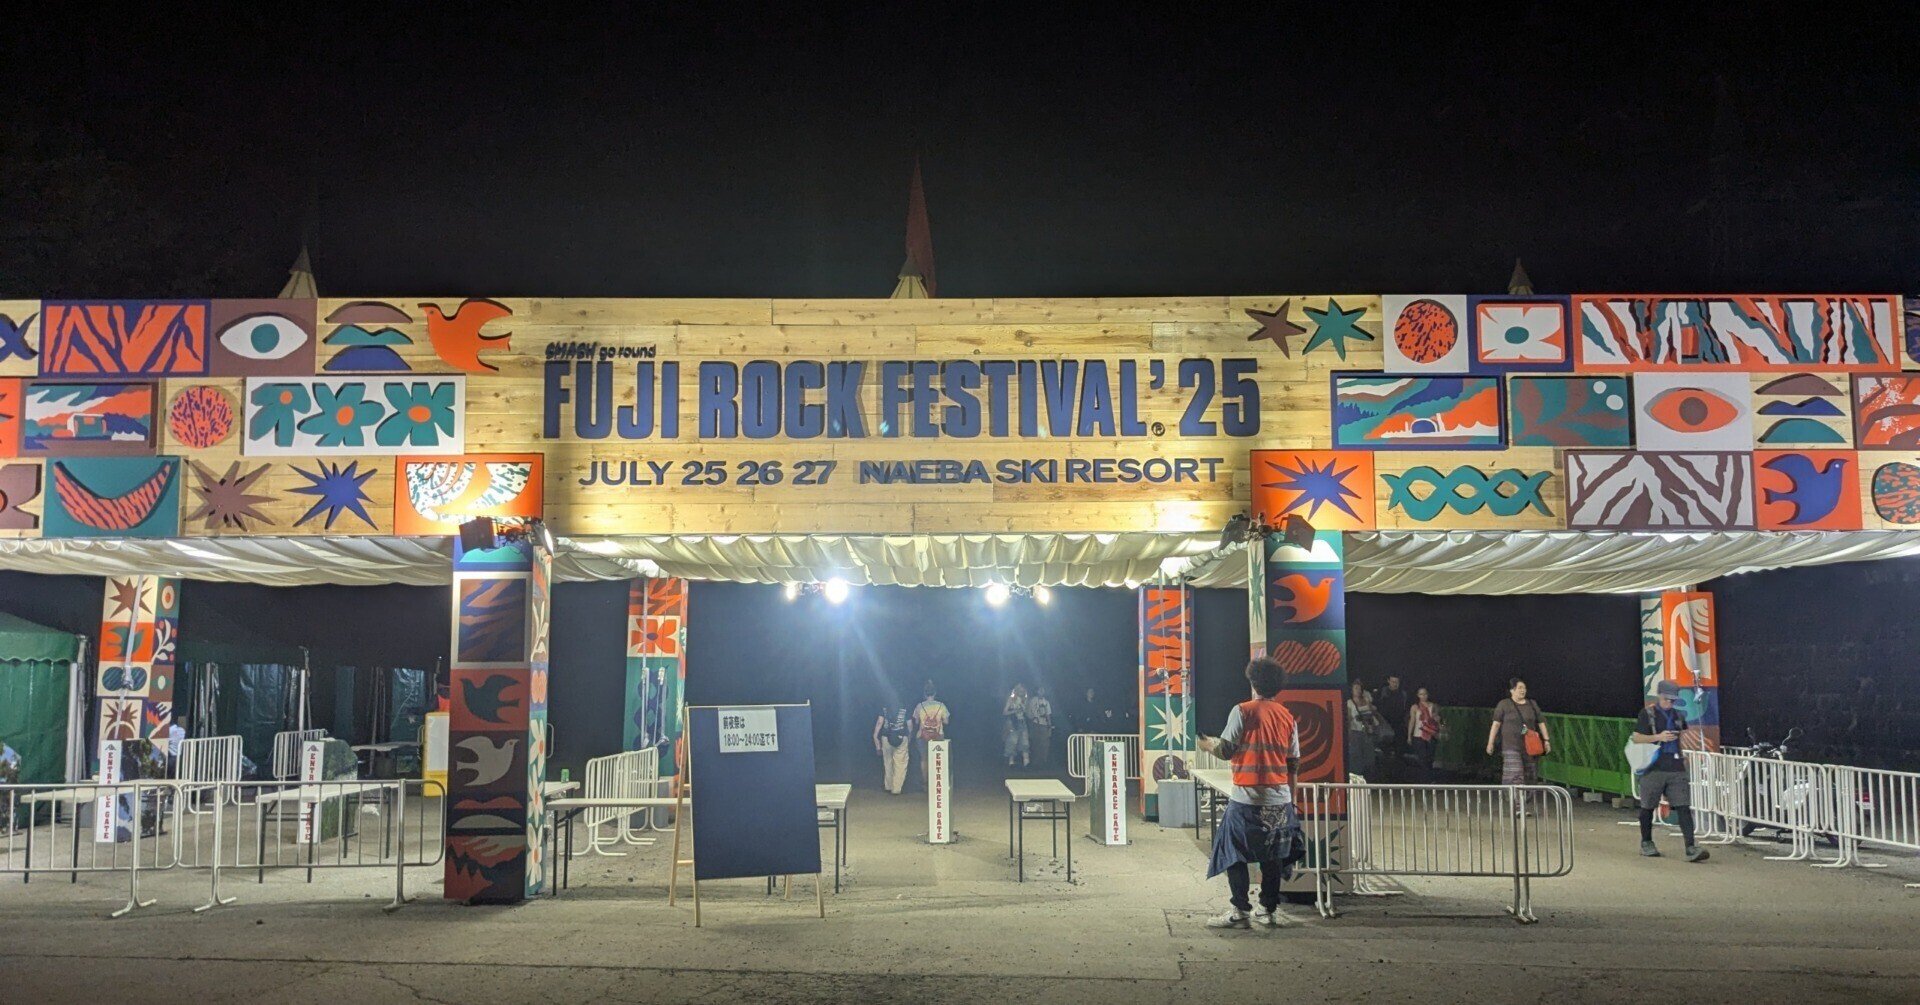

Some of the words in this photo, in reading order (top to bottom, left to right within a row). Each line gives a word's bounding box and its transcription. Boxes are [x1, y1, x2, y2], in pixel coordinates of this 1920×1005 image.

[599, 345, 616, 360] go
[618, 343, 657, 358] round
[543, 360, 679, 439] FUJI
[698, 360, 868, 439] ROCK
[578, 461, 674, 486] JULY
[681, 461, 728, 486] 25
[736, 461, 784, 486] 26
[792, 461, 838, 486] 27
[860, 460, 994, 484] NAEBA
[995, 458, 1058, 483] SKI
[1066, 457, 1225, 483] RESORT
[935, 752, 943, 808] ENTRANCE
[1111, 754, 1119, 810] ENTRANCE
